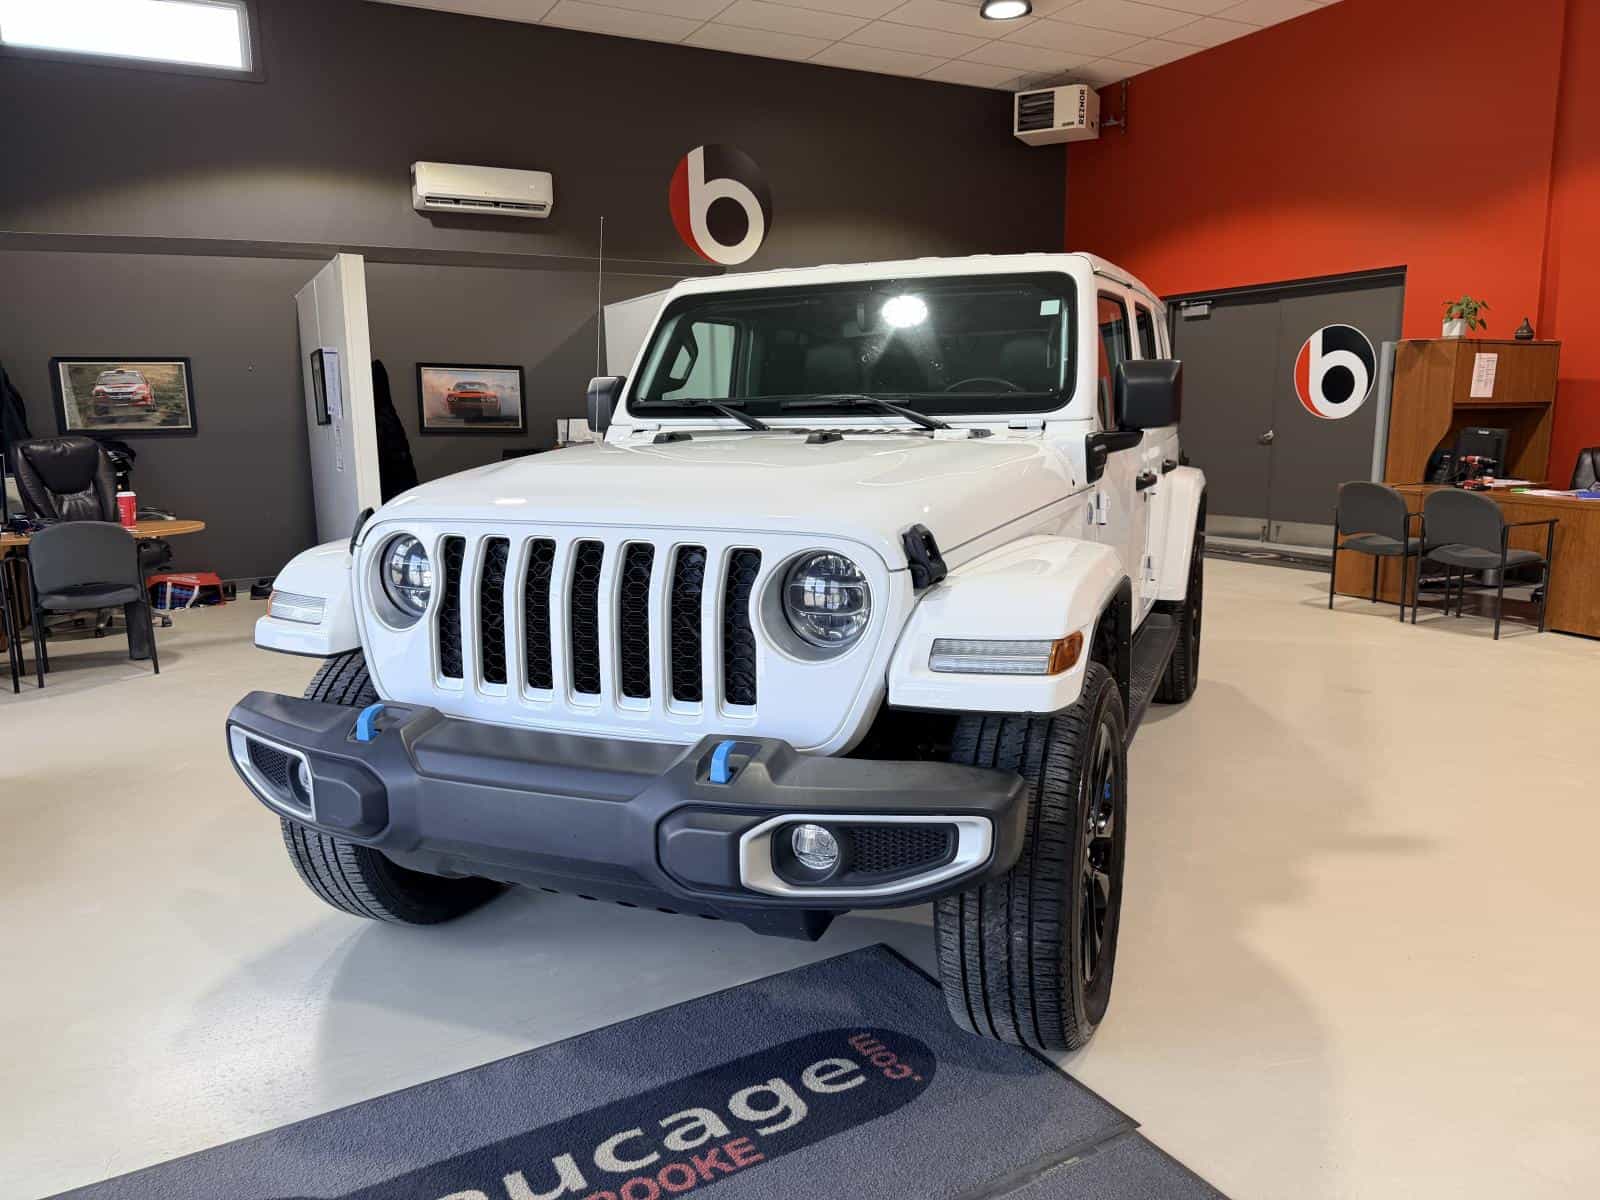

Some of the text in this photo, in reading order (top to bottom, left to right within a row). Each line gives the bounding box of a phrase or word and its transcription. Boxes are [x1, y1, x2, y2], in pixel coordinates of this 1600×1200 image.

[1078, 87, 1086, 125] REZNOR
[687, 145, 765, 265] b
[1308, 327, 1369, 419] b
